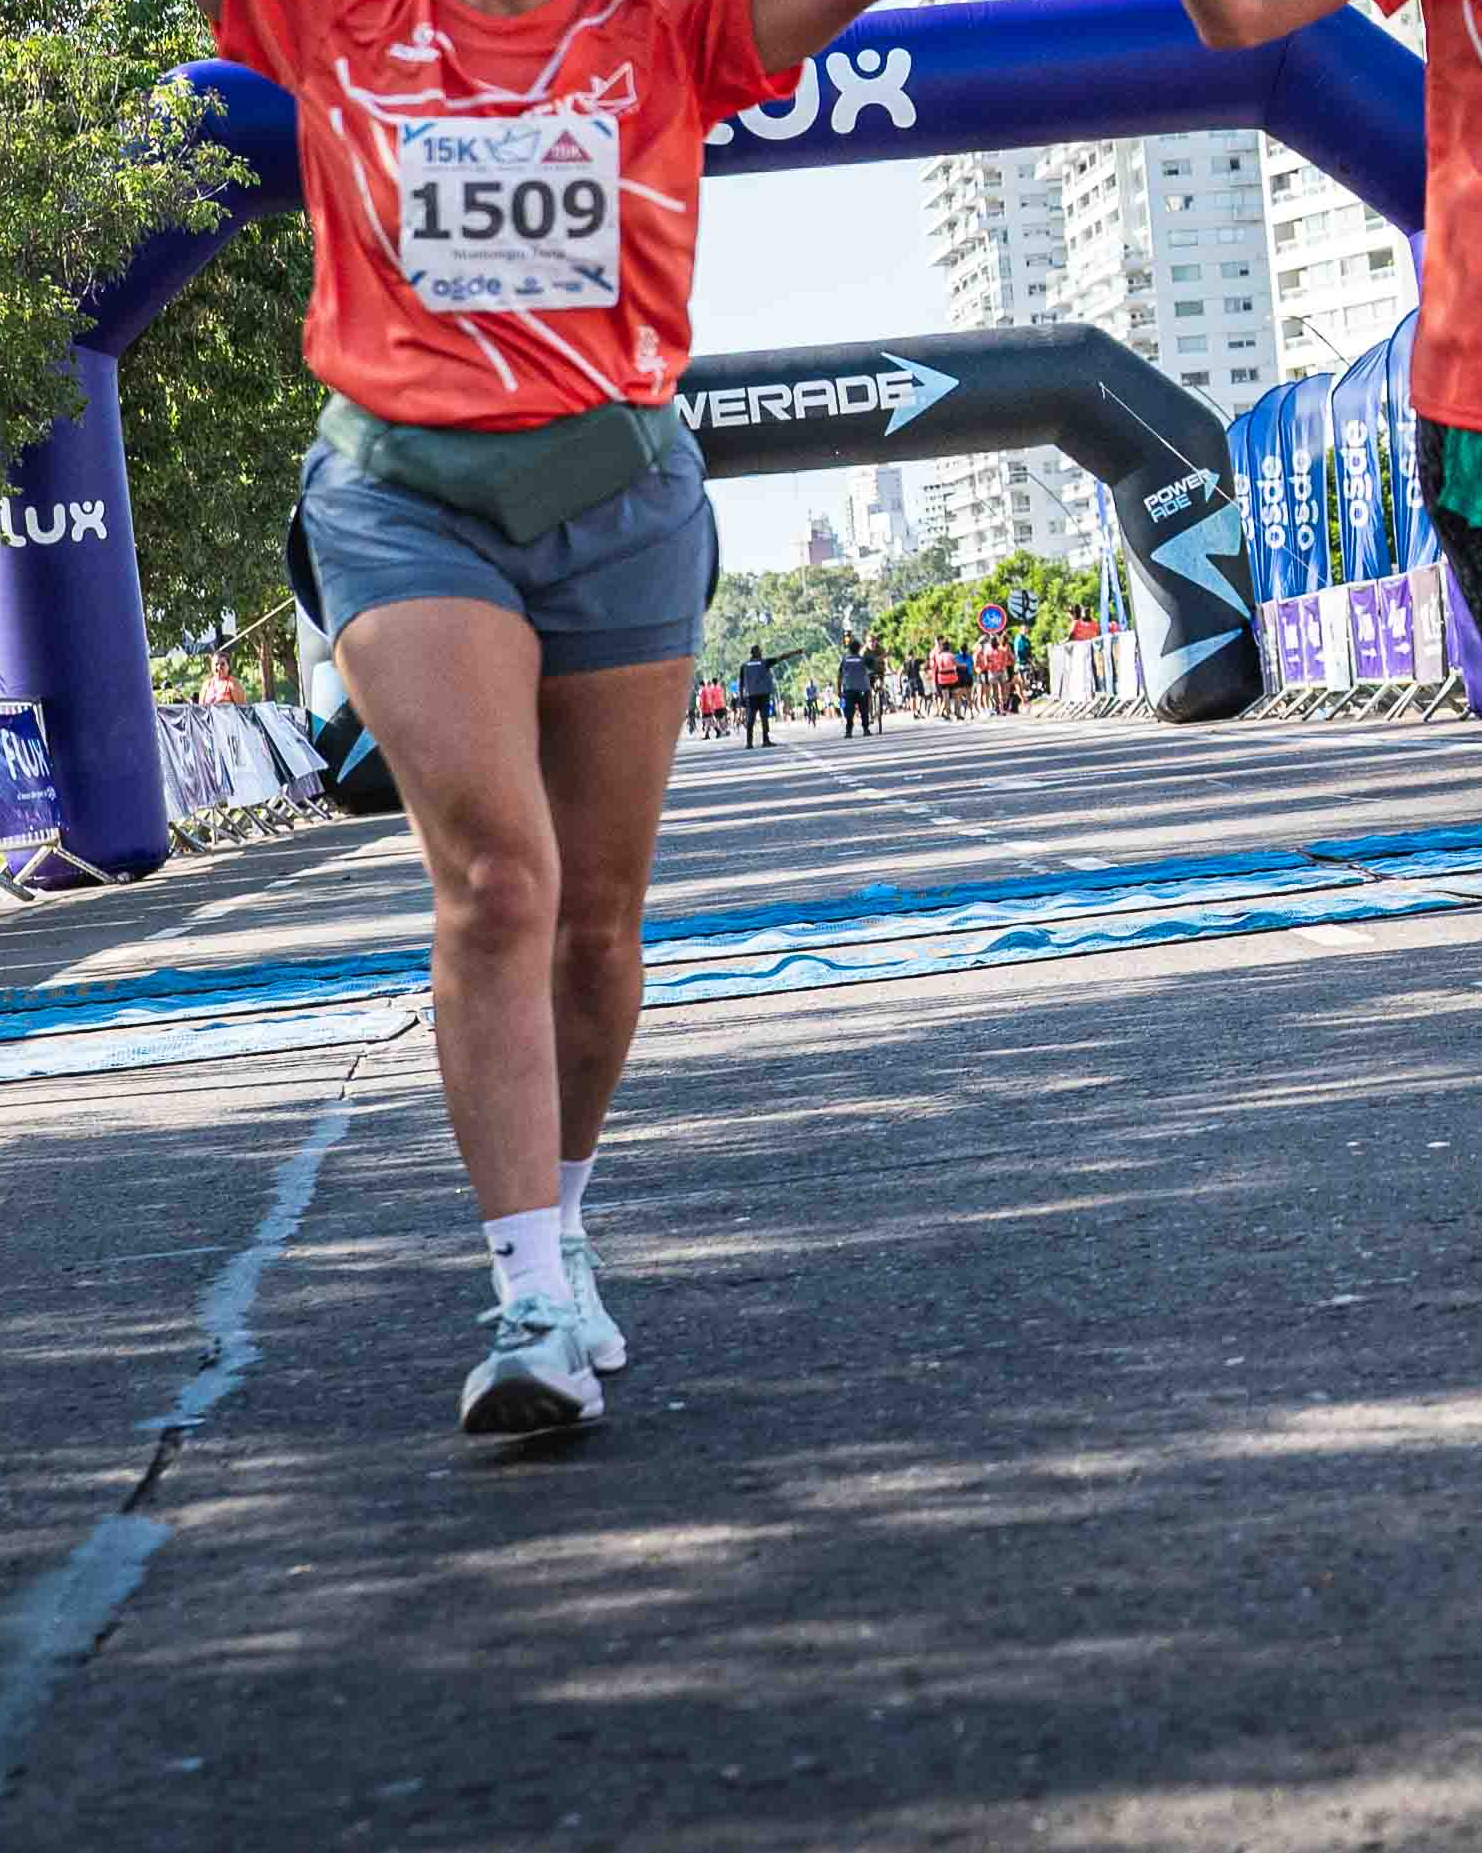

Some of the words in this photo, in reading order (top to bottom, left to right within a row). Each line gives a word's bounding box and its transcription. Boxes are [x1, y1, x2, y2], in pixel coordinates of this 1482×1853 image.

[423, 136, 479, 164] 15K
[411, 179, 606, 240] 1509
[673, 370, 916, 431] WERADE
[1143, 468, 1212, 512] POWER
[1150, 493, 1192, 523] ADE
